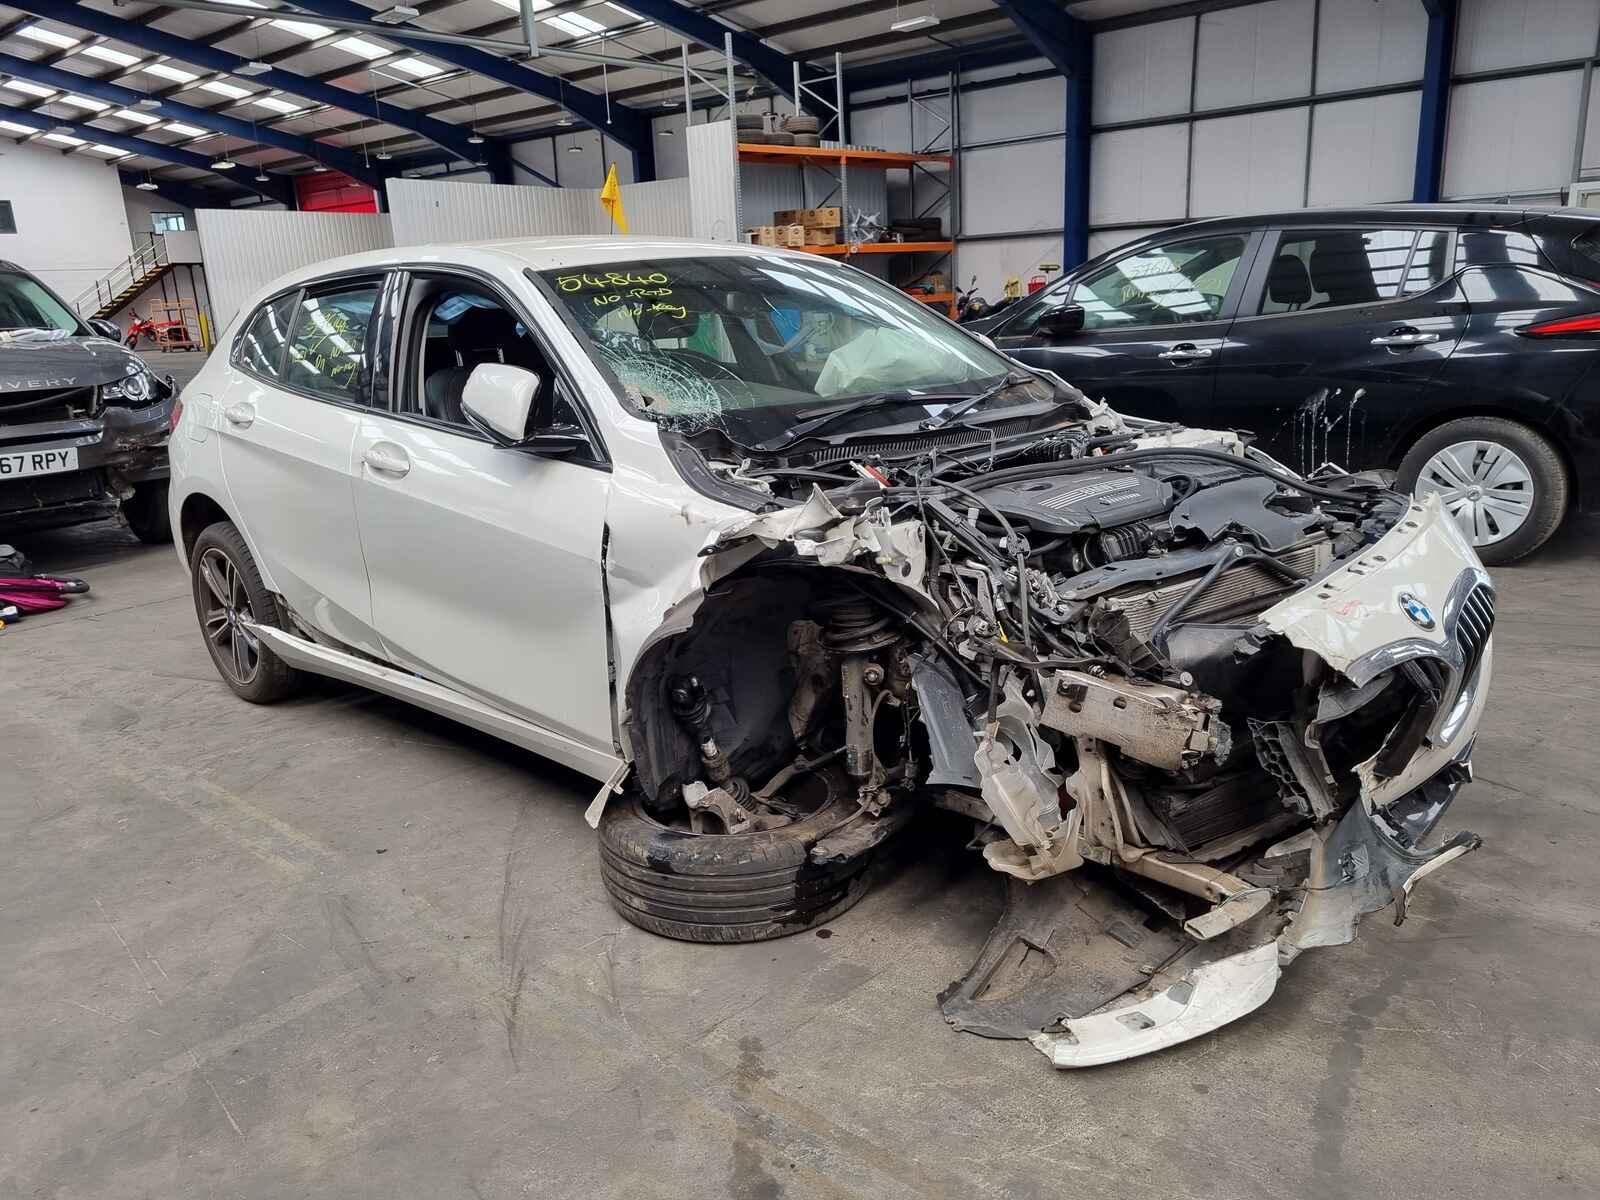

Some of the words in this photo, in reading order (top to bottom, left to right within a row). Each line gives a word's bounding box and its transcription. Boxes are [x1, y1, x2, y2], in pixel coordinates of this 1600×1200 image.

[557, 272, 668, 292] 54840
[0, 377, 77, 390] VERY
[0, 456, 25, 474] 67
[31, 451, 69, 471] RPY
